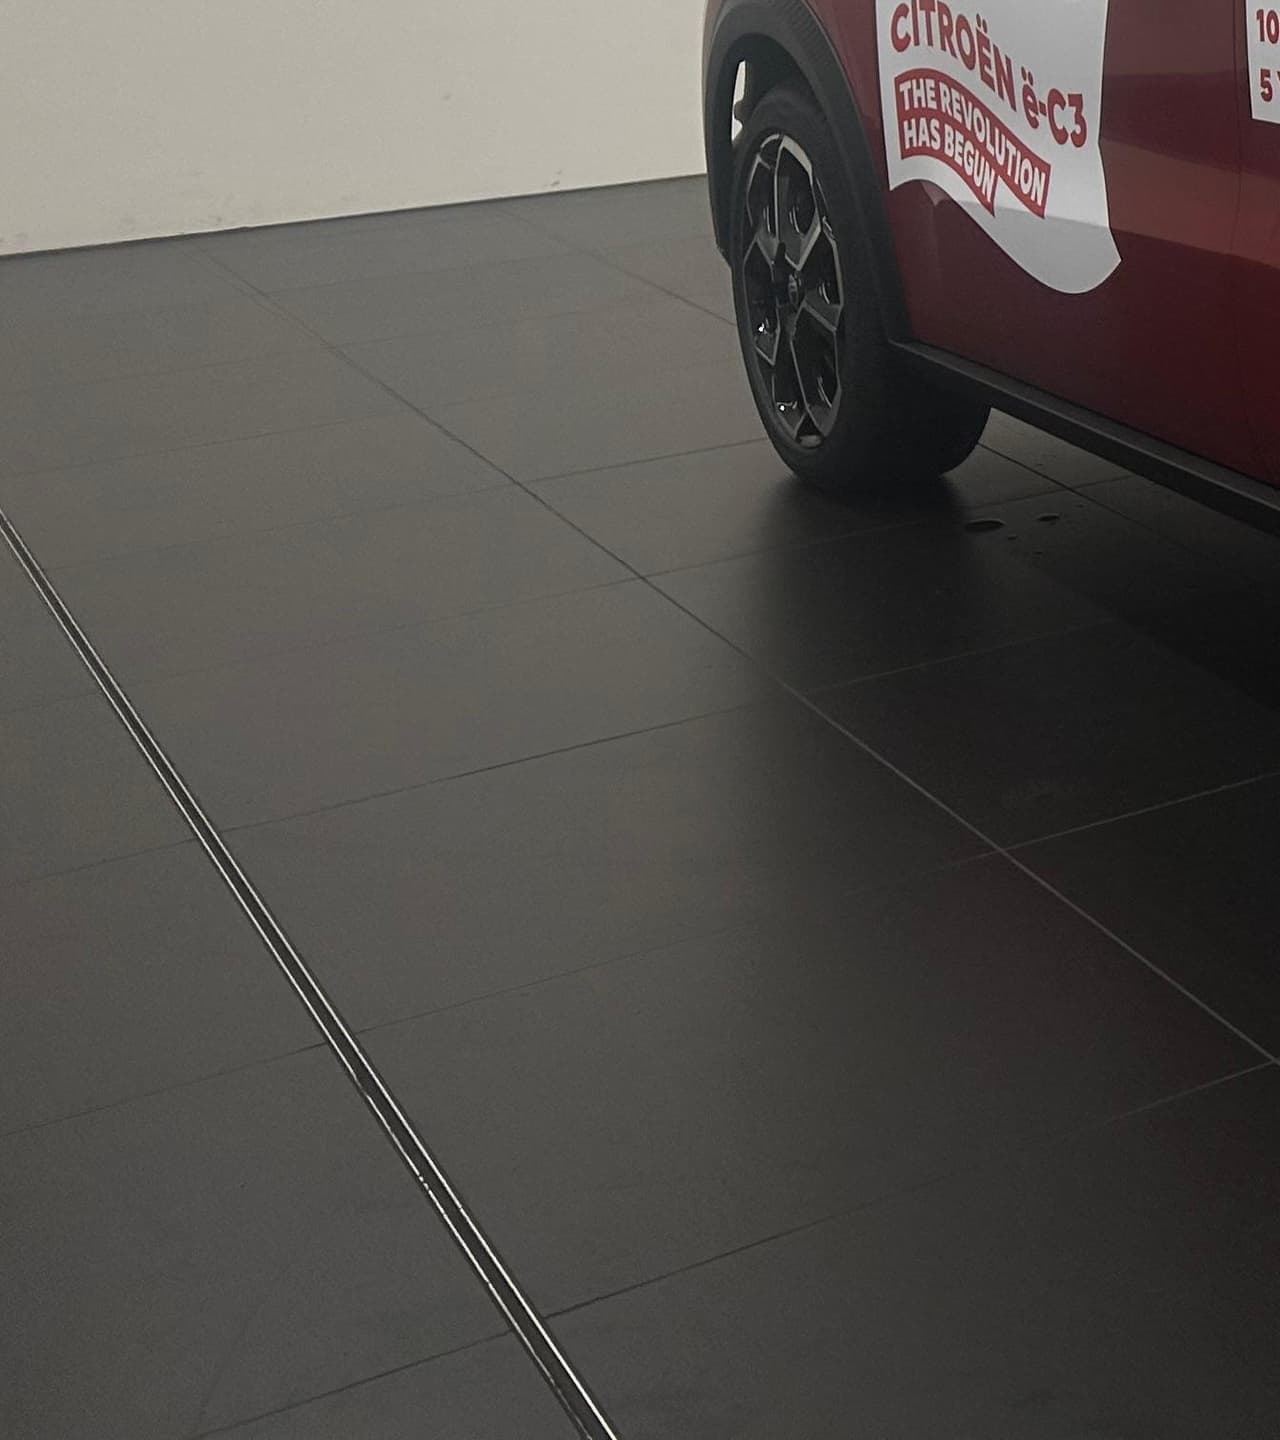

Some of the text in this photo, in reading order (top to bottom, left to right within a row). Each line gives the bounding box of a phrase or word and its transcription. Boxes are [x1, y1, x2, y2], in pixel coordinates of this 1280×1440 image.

[1020, 66, 1087, 148] ë-C3
[1260, 68, 1273, 102] 5
[900, 78, 1045, 206] THE REVOLUTION
[903, 117, 996, 202] HAS BEGUN
